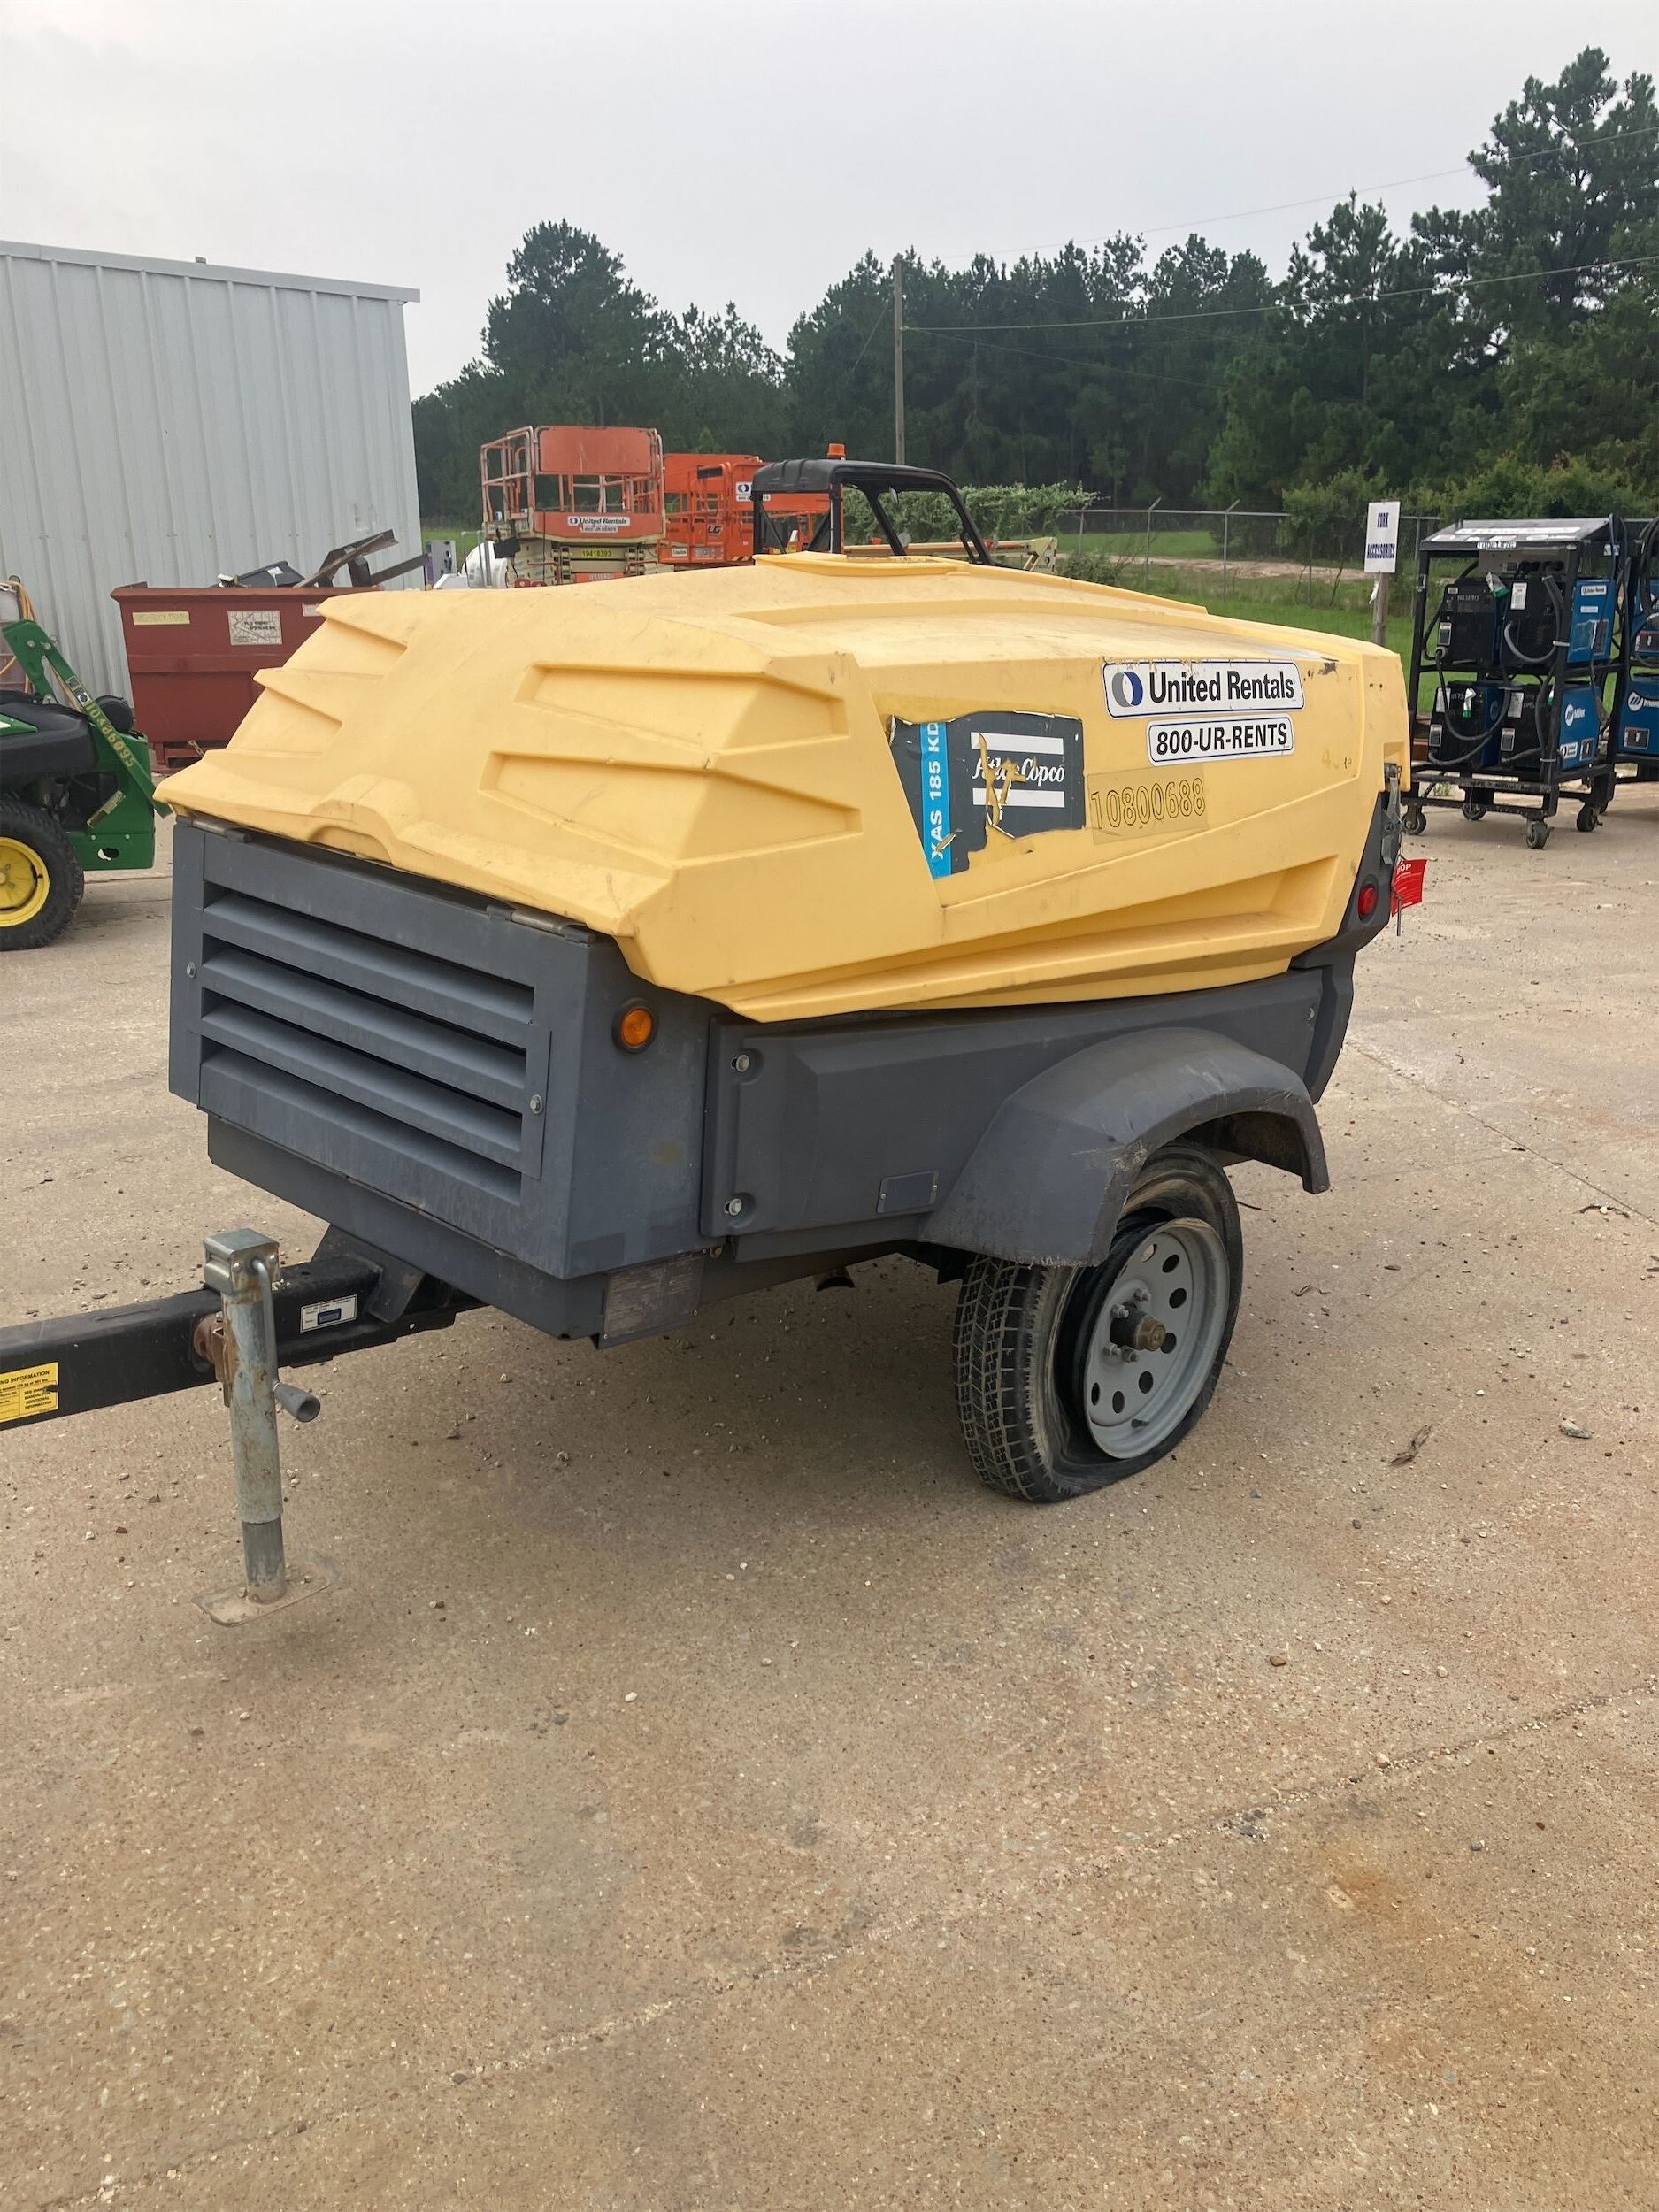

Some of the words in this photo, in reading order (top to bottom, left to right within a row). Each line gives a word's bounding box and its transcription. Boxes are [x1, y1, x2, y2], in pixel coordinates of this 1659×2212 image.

[1377, 512, 1389, 528] FORK
[1367, 543, 1395, 559] ACCESSORIES
[1149, 671, 1222, 703] United
[1227, 671, 1294, 700] Rentals
[1156, 722, 1287, 756] 800-UR-RENTS
[929, 760, 941, 801] 185
[1021, 758, 1065, 787] Copco
[1091, 777, 1206, 829] 10800688
[930, 809, 943, 859] XAS
[11, 1371, 50, 1383] INFORMATION
